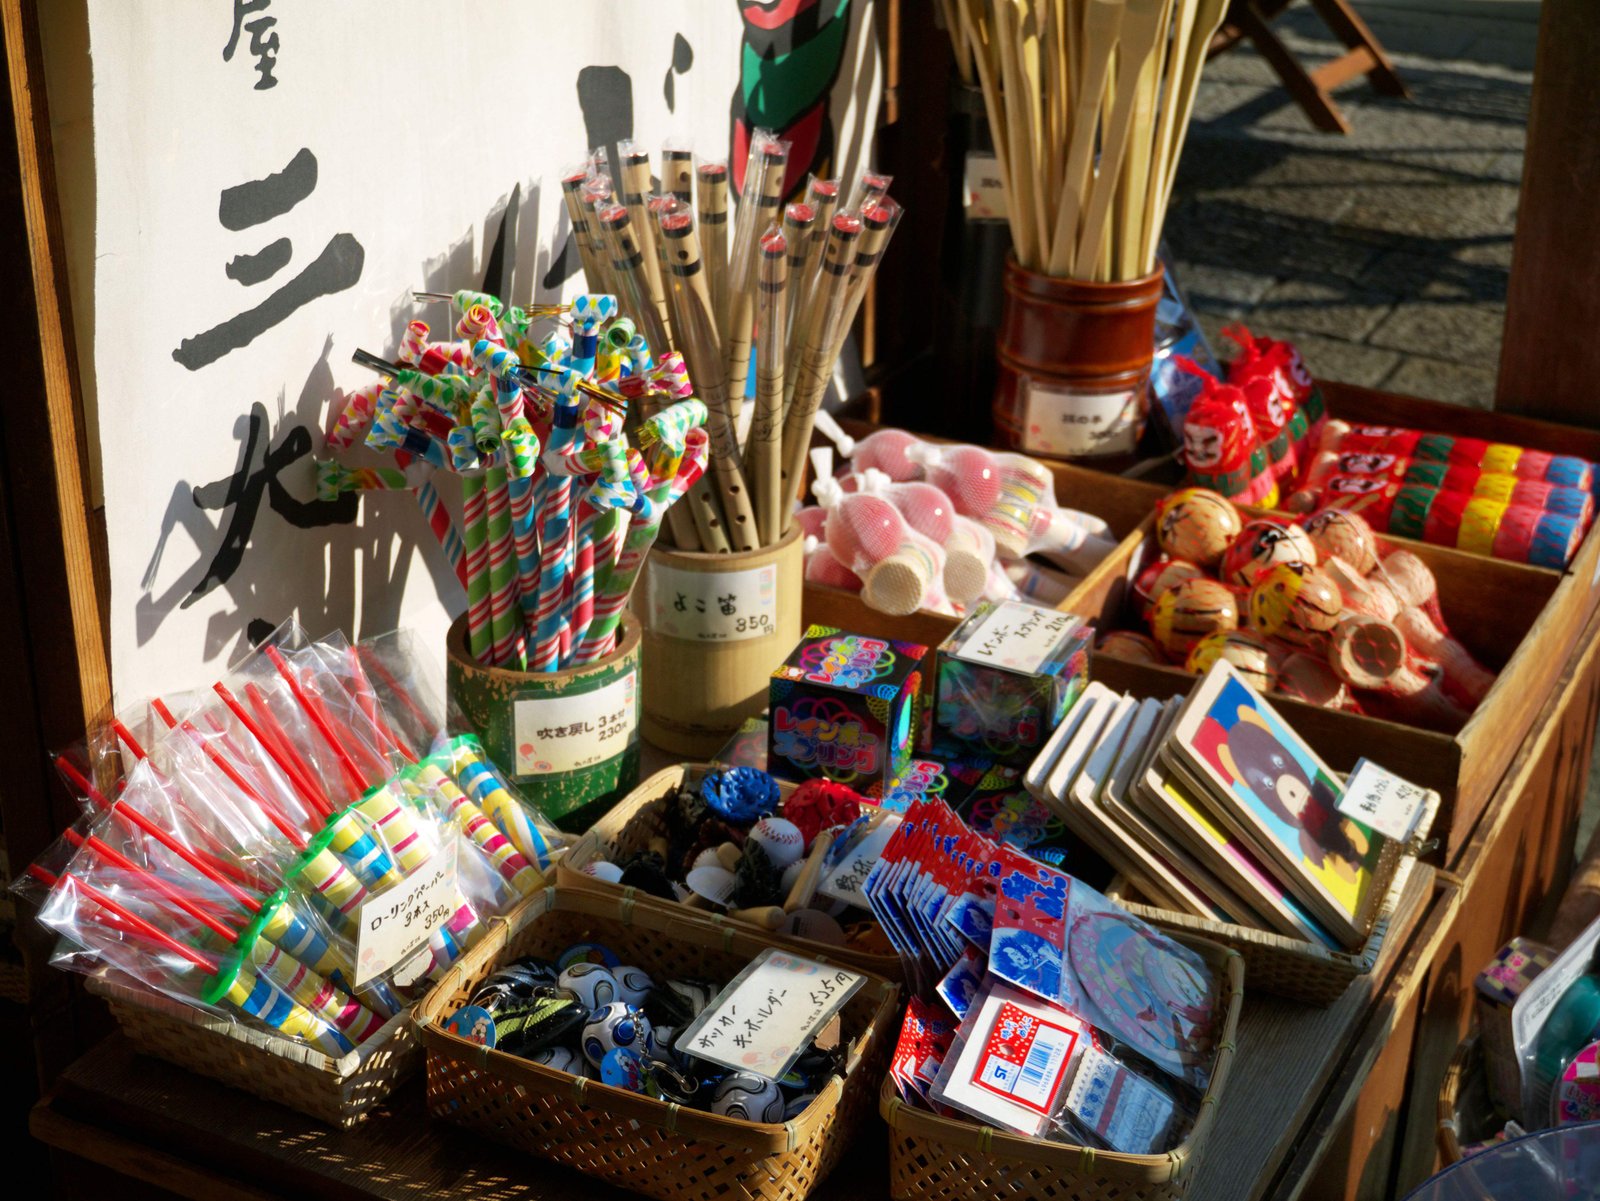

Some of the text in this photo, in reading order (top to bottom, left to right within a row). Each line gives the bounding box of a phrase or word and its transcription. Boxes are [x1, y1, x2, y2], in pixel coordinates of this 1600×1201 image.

[673, 591, 737, 615] よこ笛
[536, 721, 595, 741] 吹き戻し
[698, 1005, 736, 1049] サッカー
[733, 988, 788, 1049] キーホルダー
[994, 1065, 1008, 1080] ST
